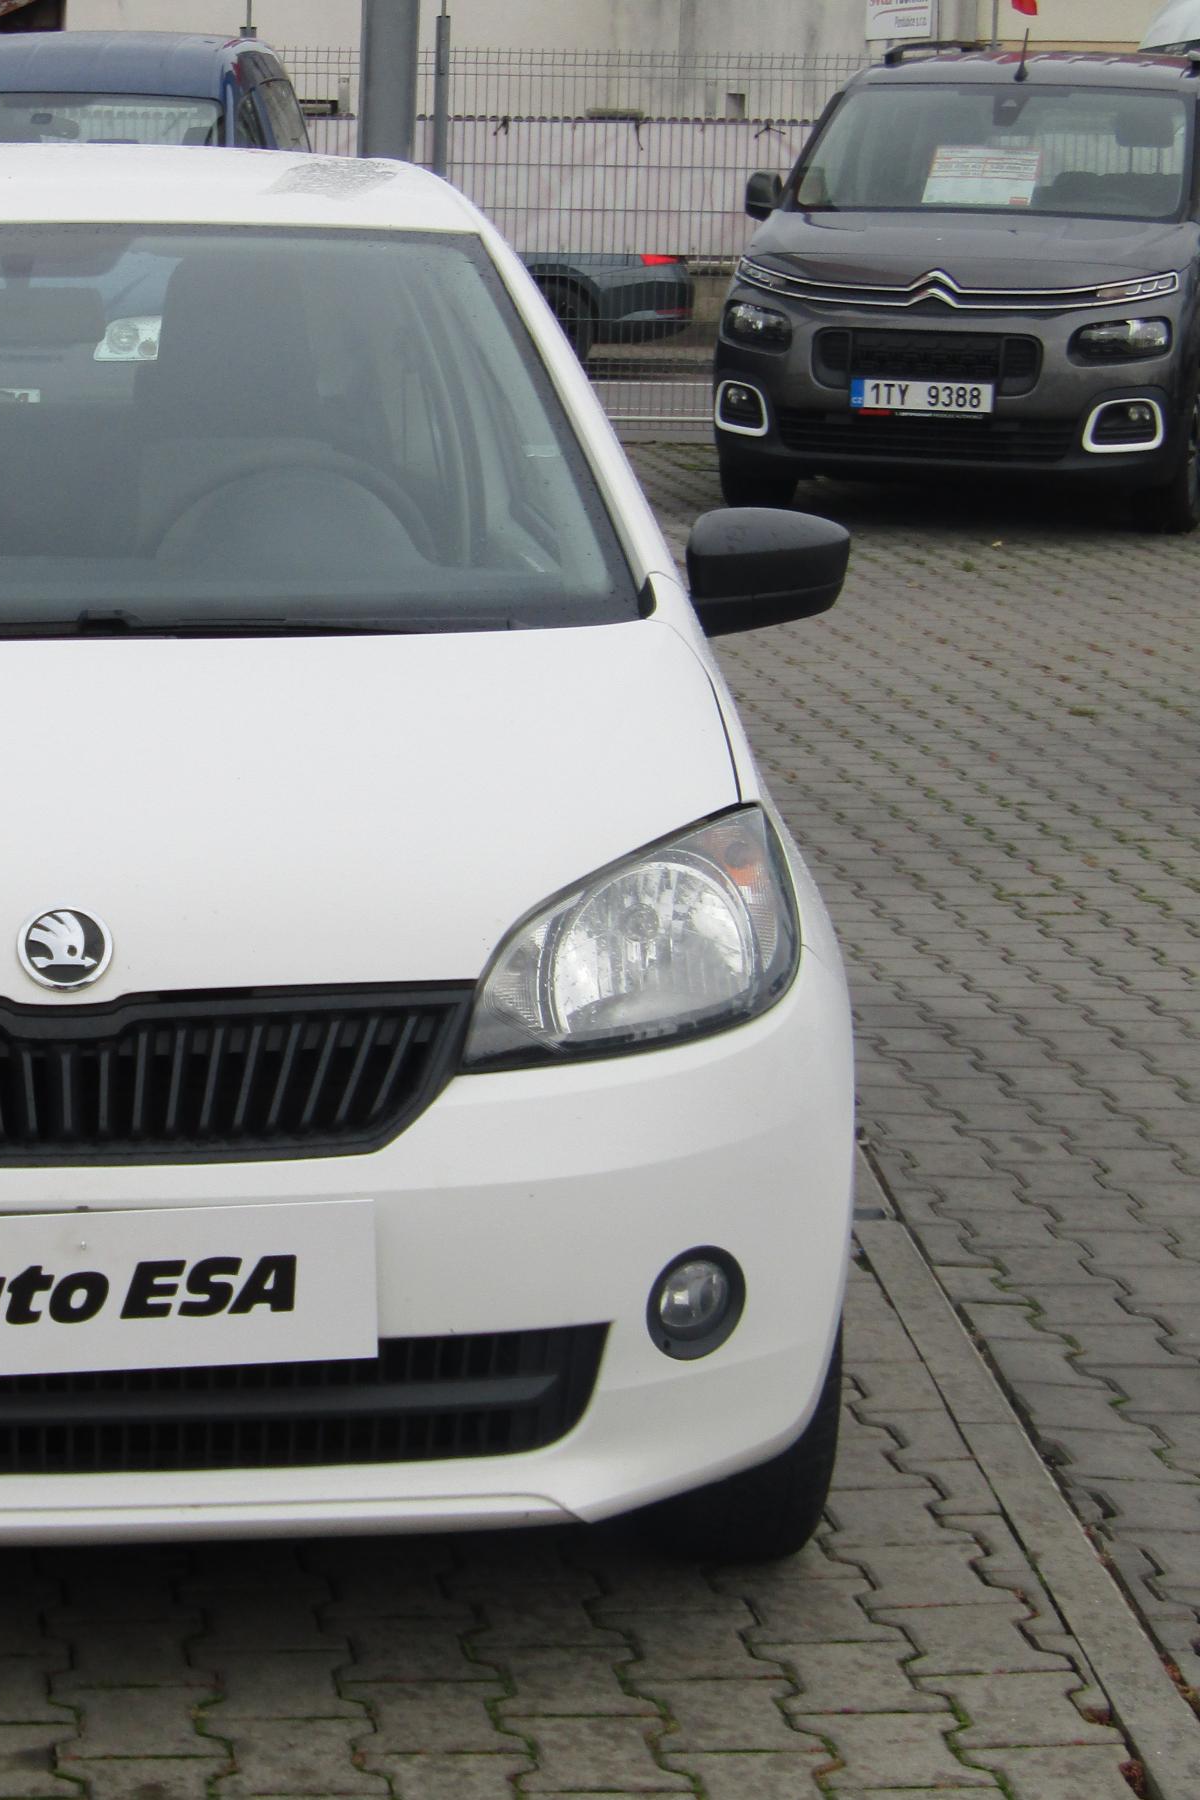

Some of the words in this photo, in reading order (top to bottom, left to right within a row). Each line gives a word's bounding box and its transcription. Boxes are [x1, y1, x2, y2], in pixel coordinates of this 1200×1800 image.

[851, 396, 863, 404] CZ
[870, 383, 909, 405] 1TY
[927, 385, 981, 408] 9388
[120, 1254, 298, 1319] ESA
